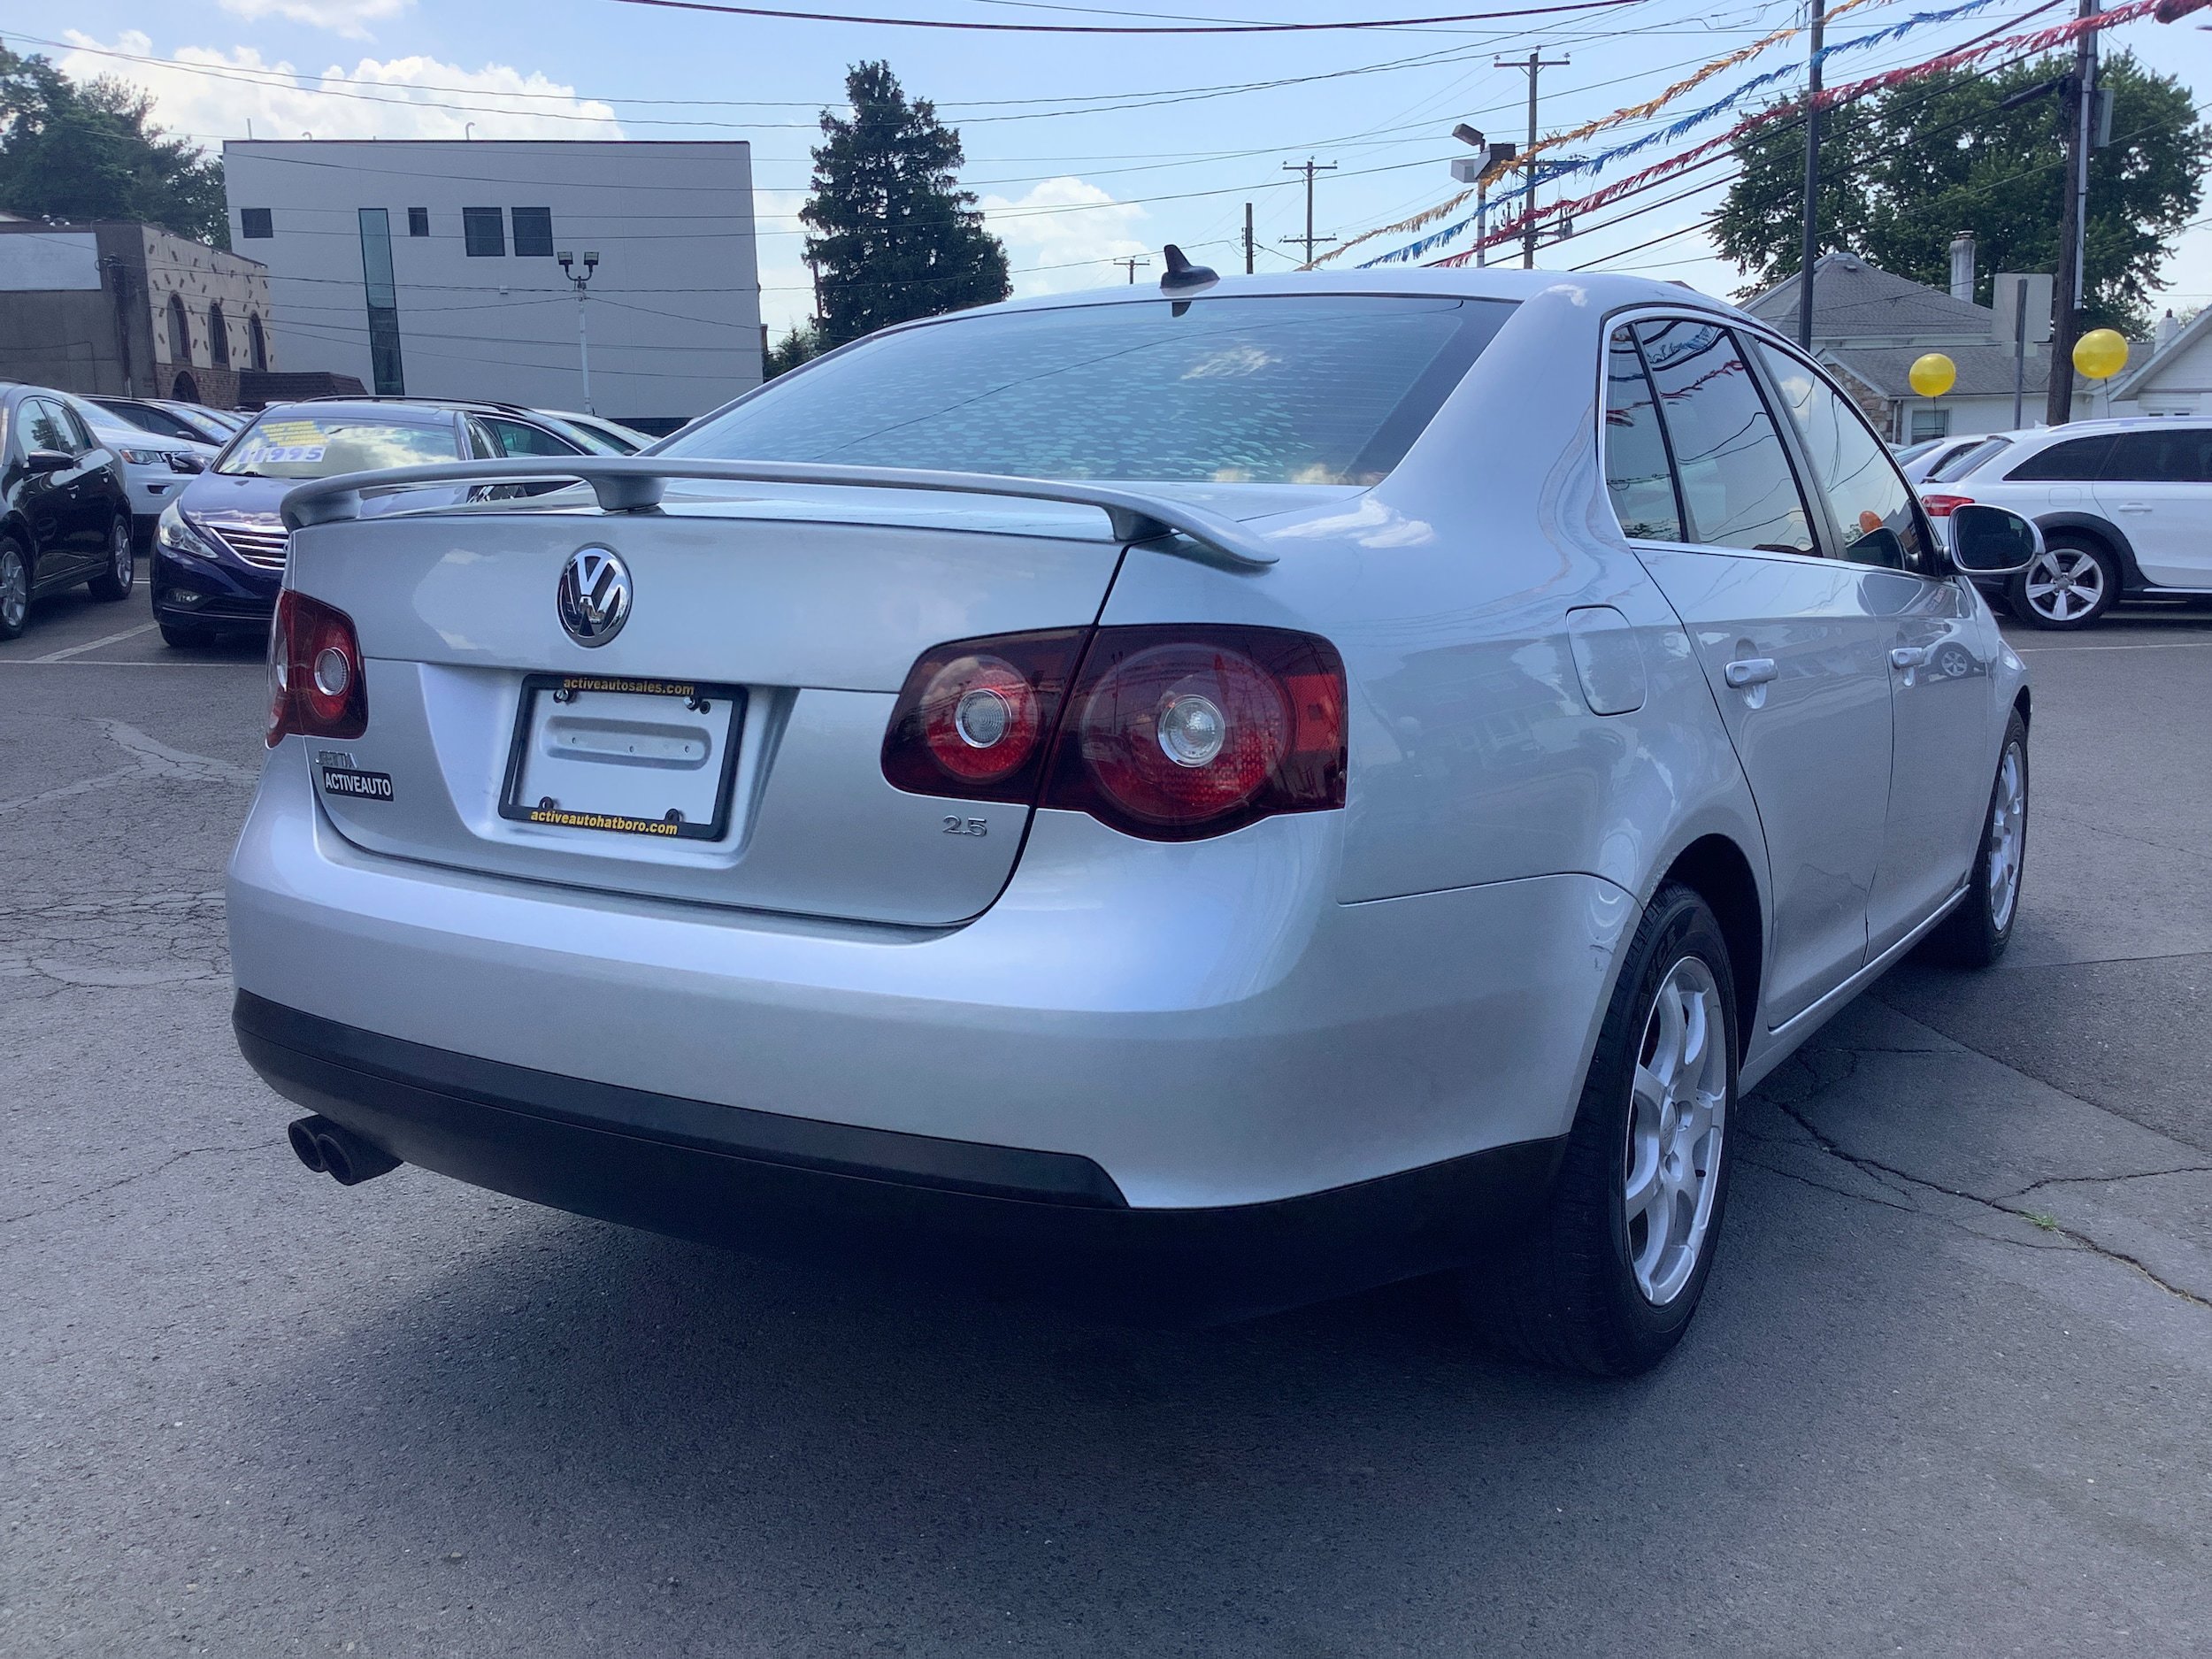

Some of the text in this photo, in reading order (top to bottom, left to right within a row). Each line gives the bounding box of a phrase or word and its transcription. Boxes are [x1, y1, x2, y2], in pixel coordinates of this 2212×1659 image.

[563, 677, 695, 695] activeautosales.com
[325, 772, 392, 796] ACTIVEAUTO
[531, 810, 678, 835] activeautohatboro.com
[942, 815, 987, 837] 2.5
